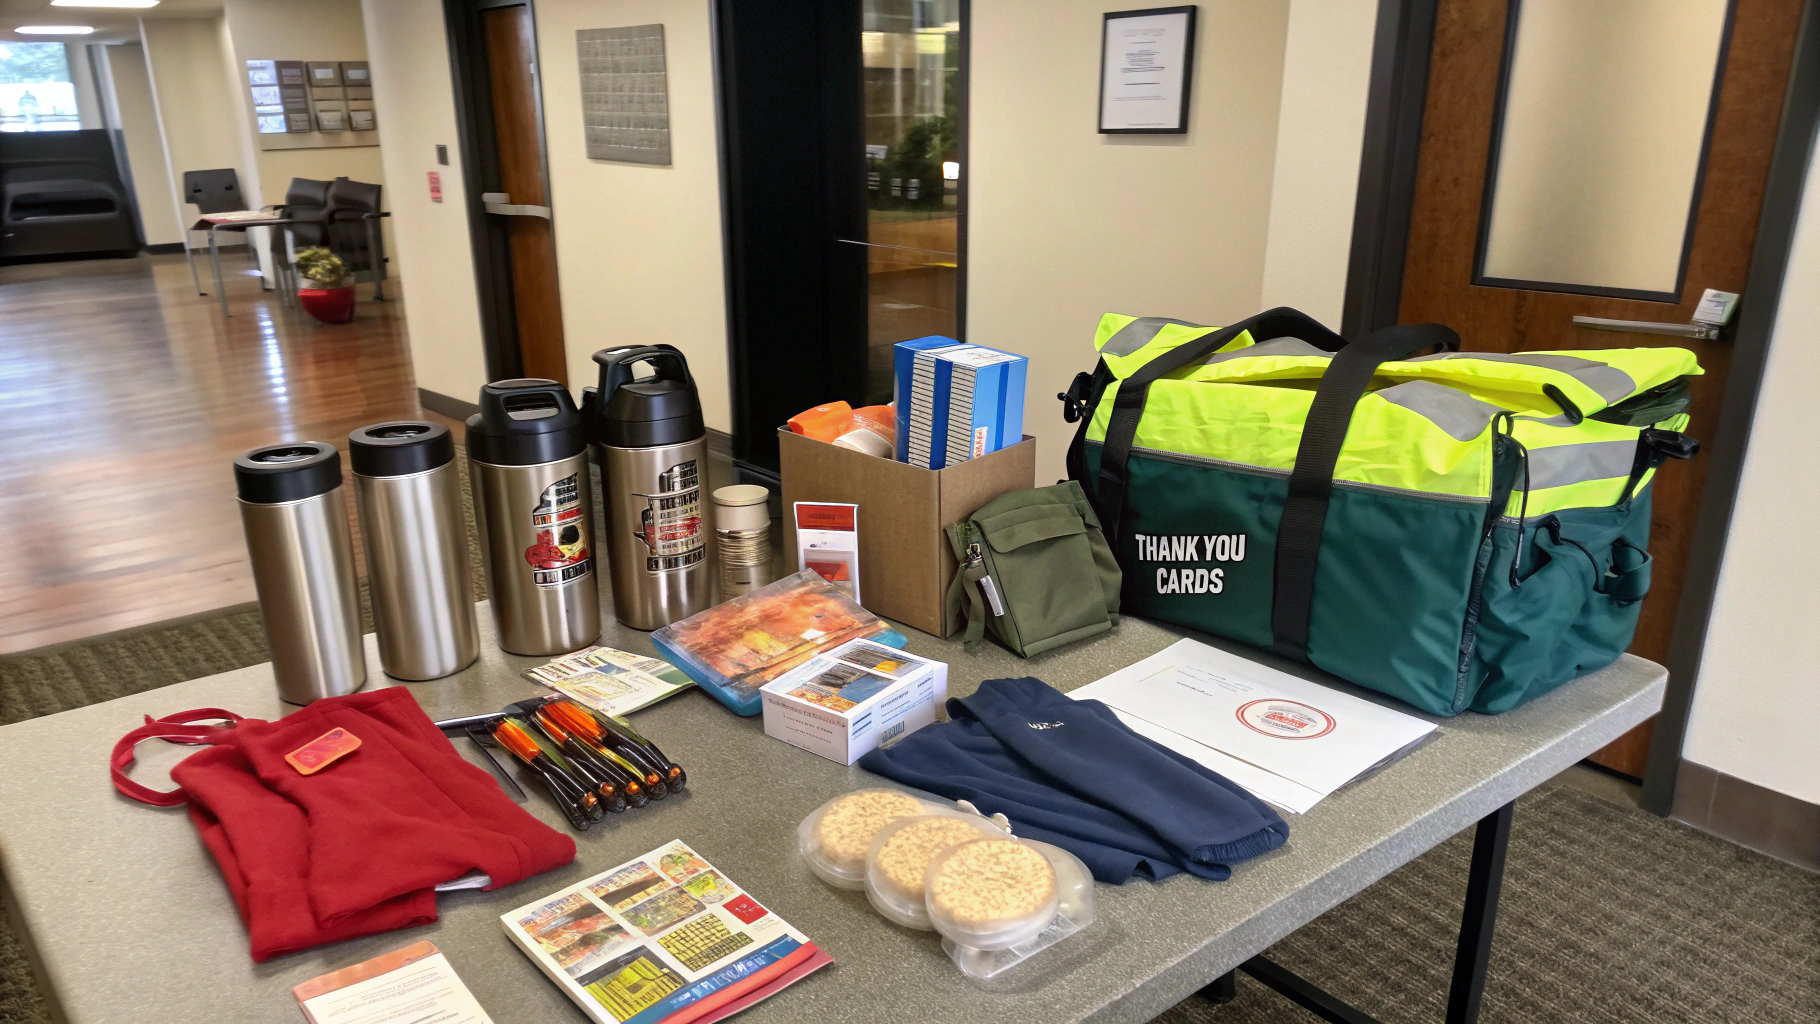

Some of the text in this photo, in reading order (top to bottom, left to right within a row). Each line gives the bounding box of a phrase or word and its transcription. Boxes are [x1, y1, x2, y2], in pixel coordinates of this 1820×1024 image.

[1135, 534, 1246, 562] THANK YOU
[1156, 567, 1225, 595] CARDS
